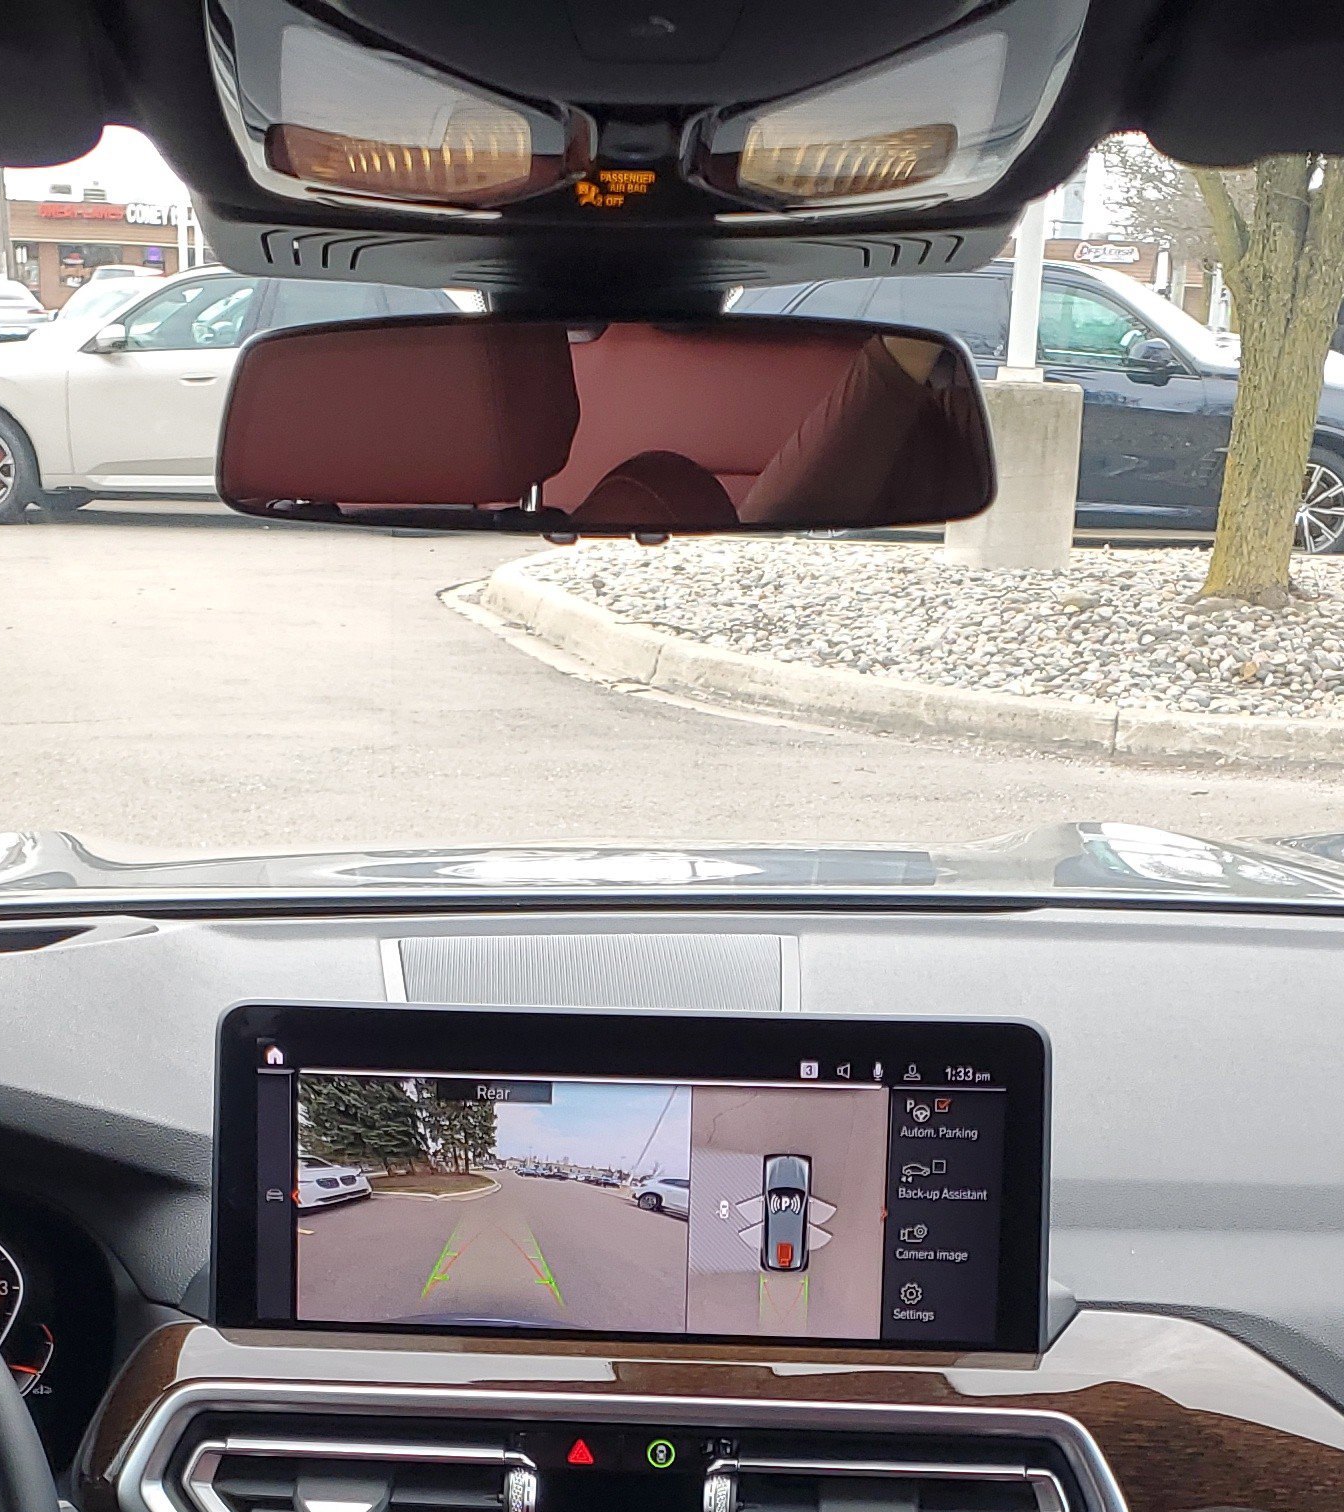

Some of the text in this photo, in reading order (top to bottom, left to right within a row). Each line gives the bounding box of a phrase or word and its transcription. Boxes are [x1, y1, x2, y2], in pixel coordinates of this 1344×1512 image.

[600, 173, 655, 183] PASSENGER
[805, 1065, 813, 1076] 3
[944, 1067, 991, 1083] 1:33 pm
[476, 1085, 511, 1101] Rear
[900, 1126, 979, 1141] Autom. Parking
[898, 1187, 988, 1202] Back-up Assistant
[895, 1248, 934, 1260] Camera
[893, 1308, 935, 1322] Settings
